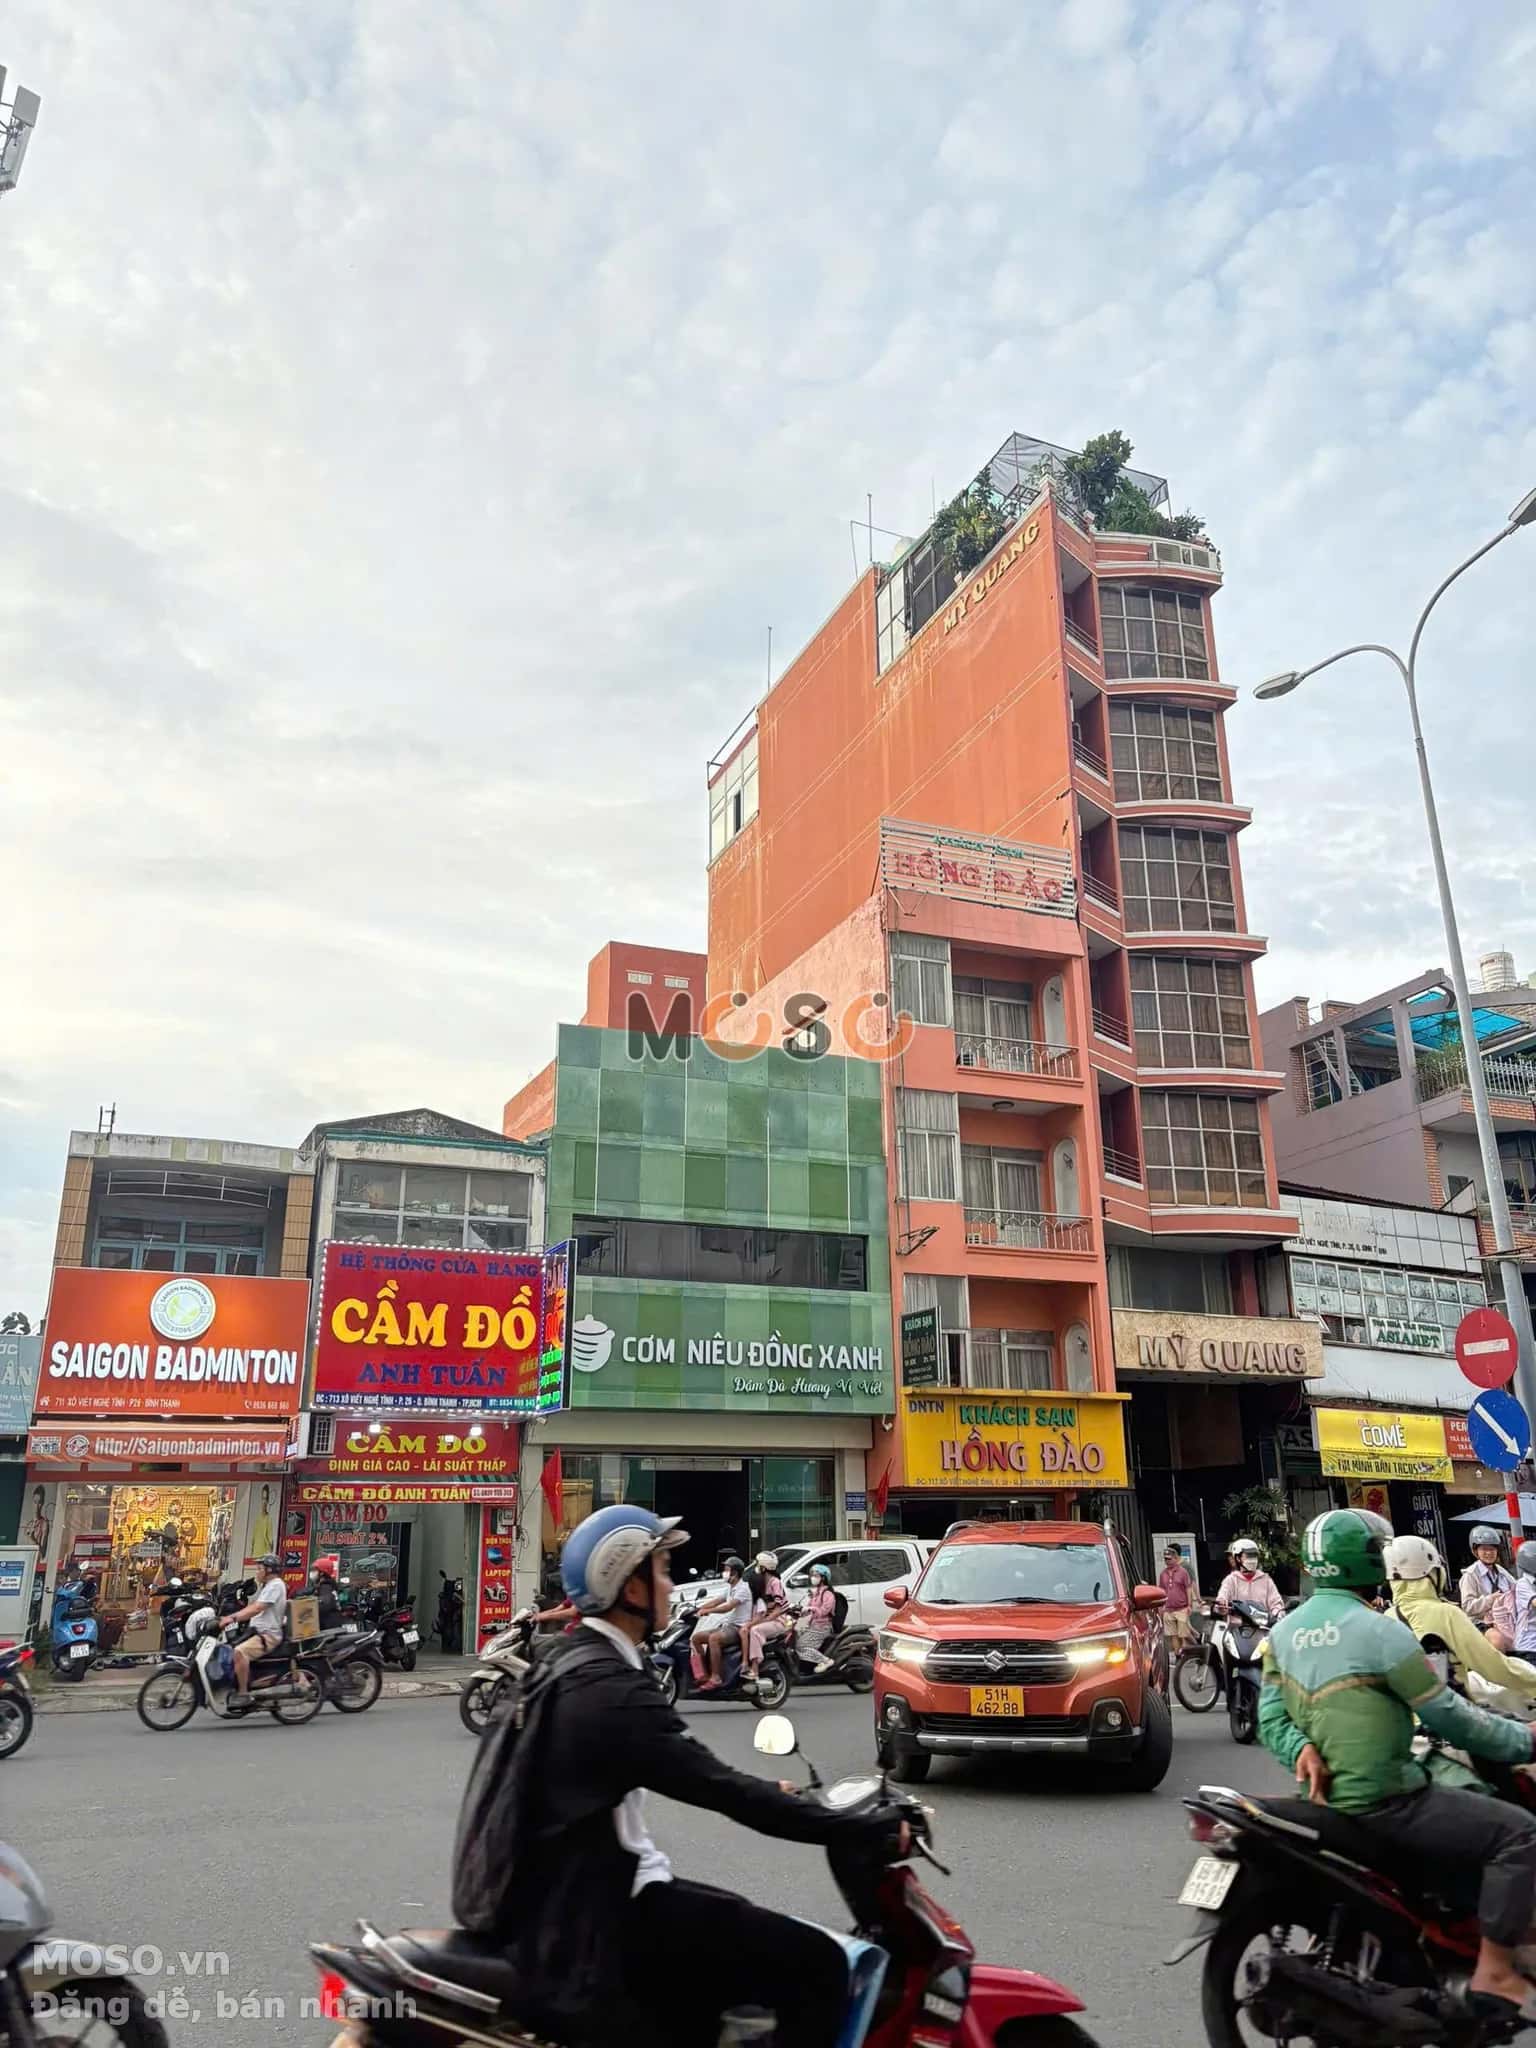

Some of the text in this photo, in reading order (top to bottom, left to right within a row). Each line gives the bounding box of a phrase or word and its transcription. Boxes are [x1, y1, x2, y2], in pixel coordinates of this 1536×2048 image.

[972, 520, 1040, 604] QUANG
[330, 1279, 449, 1347] CẦM
[462, 1285, 537, 1350] ĐỒ
[49, 1340, 298, 1385] SAIGON BADMINTON
[622, 1334, 675, 1364] CƠM
[687, 1332, 743, 1367] NIÊU
[747, 1329, 813, 1369] ĐỒNG
[818, 1346, 883, 1371] XANH
[1138, 1331, 1308, 1374] MỸ QUANG
[358, 1362, 420, 1385] ANH
[430, 1357, 507, 1387] TUẤN
[908, 1400, 945, 1414] DNTN
[960, 1400, 1076, 1432] KHÁCH SẠN
[95, 1436, 281, 1458] http://Saigonbadminton.vn
[940, 1426, 1106, 1473] HỒNG ĐÀO
[328, 1459, 358, 1474] ĐỊNH
[386, 1460, 410, 1472] CAO
[444, 1456, 475, 1473] SUẤT
[477, 1456, 508, 1473] THẤP
[394, 1487, 427, 1500] ANH
[430, 1483, 471, 1501] TUẤN
[485, 1568, 512, 1577] LAPTOP
[1292, 1620, 1340, 1652] Grab
[976, 1702, 1019, 1715] 462.88
[984, 1688, 1009, 1701] 51H
